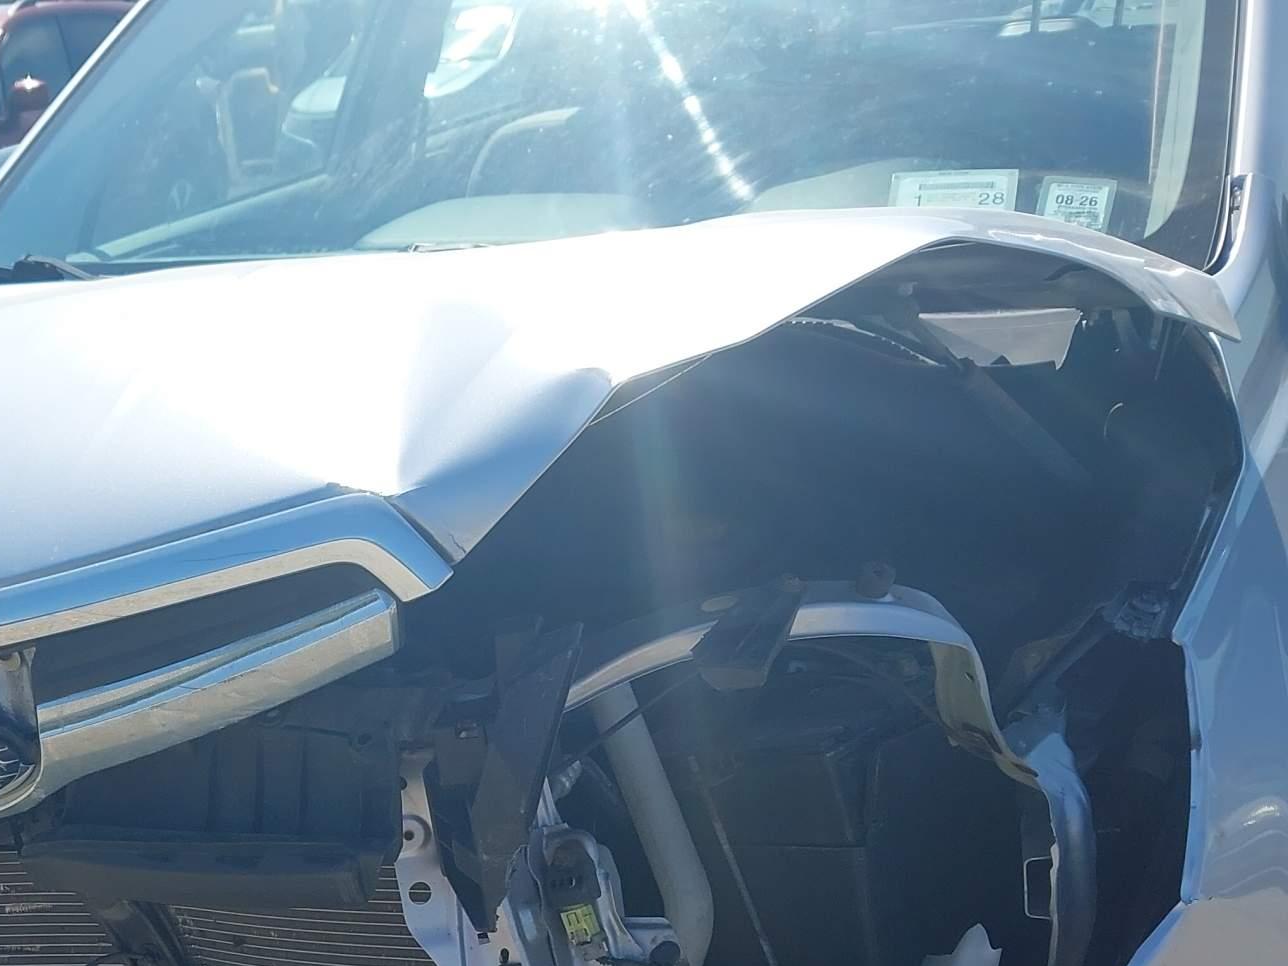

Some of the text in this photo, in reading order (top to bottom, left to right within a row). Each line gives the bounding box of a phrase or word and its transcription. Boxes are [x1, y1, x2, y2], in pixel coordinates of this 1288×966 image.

[978, 191, 1005, 206] 28
[1055, 193, 1098, 207] 08 26
